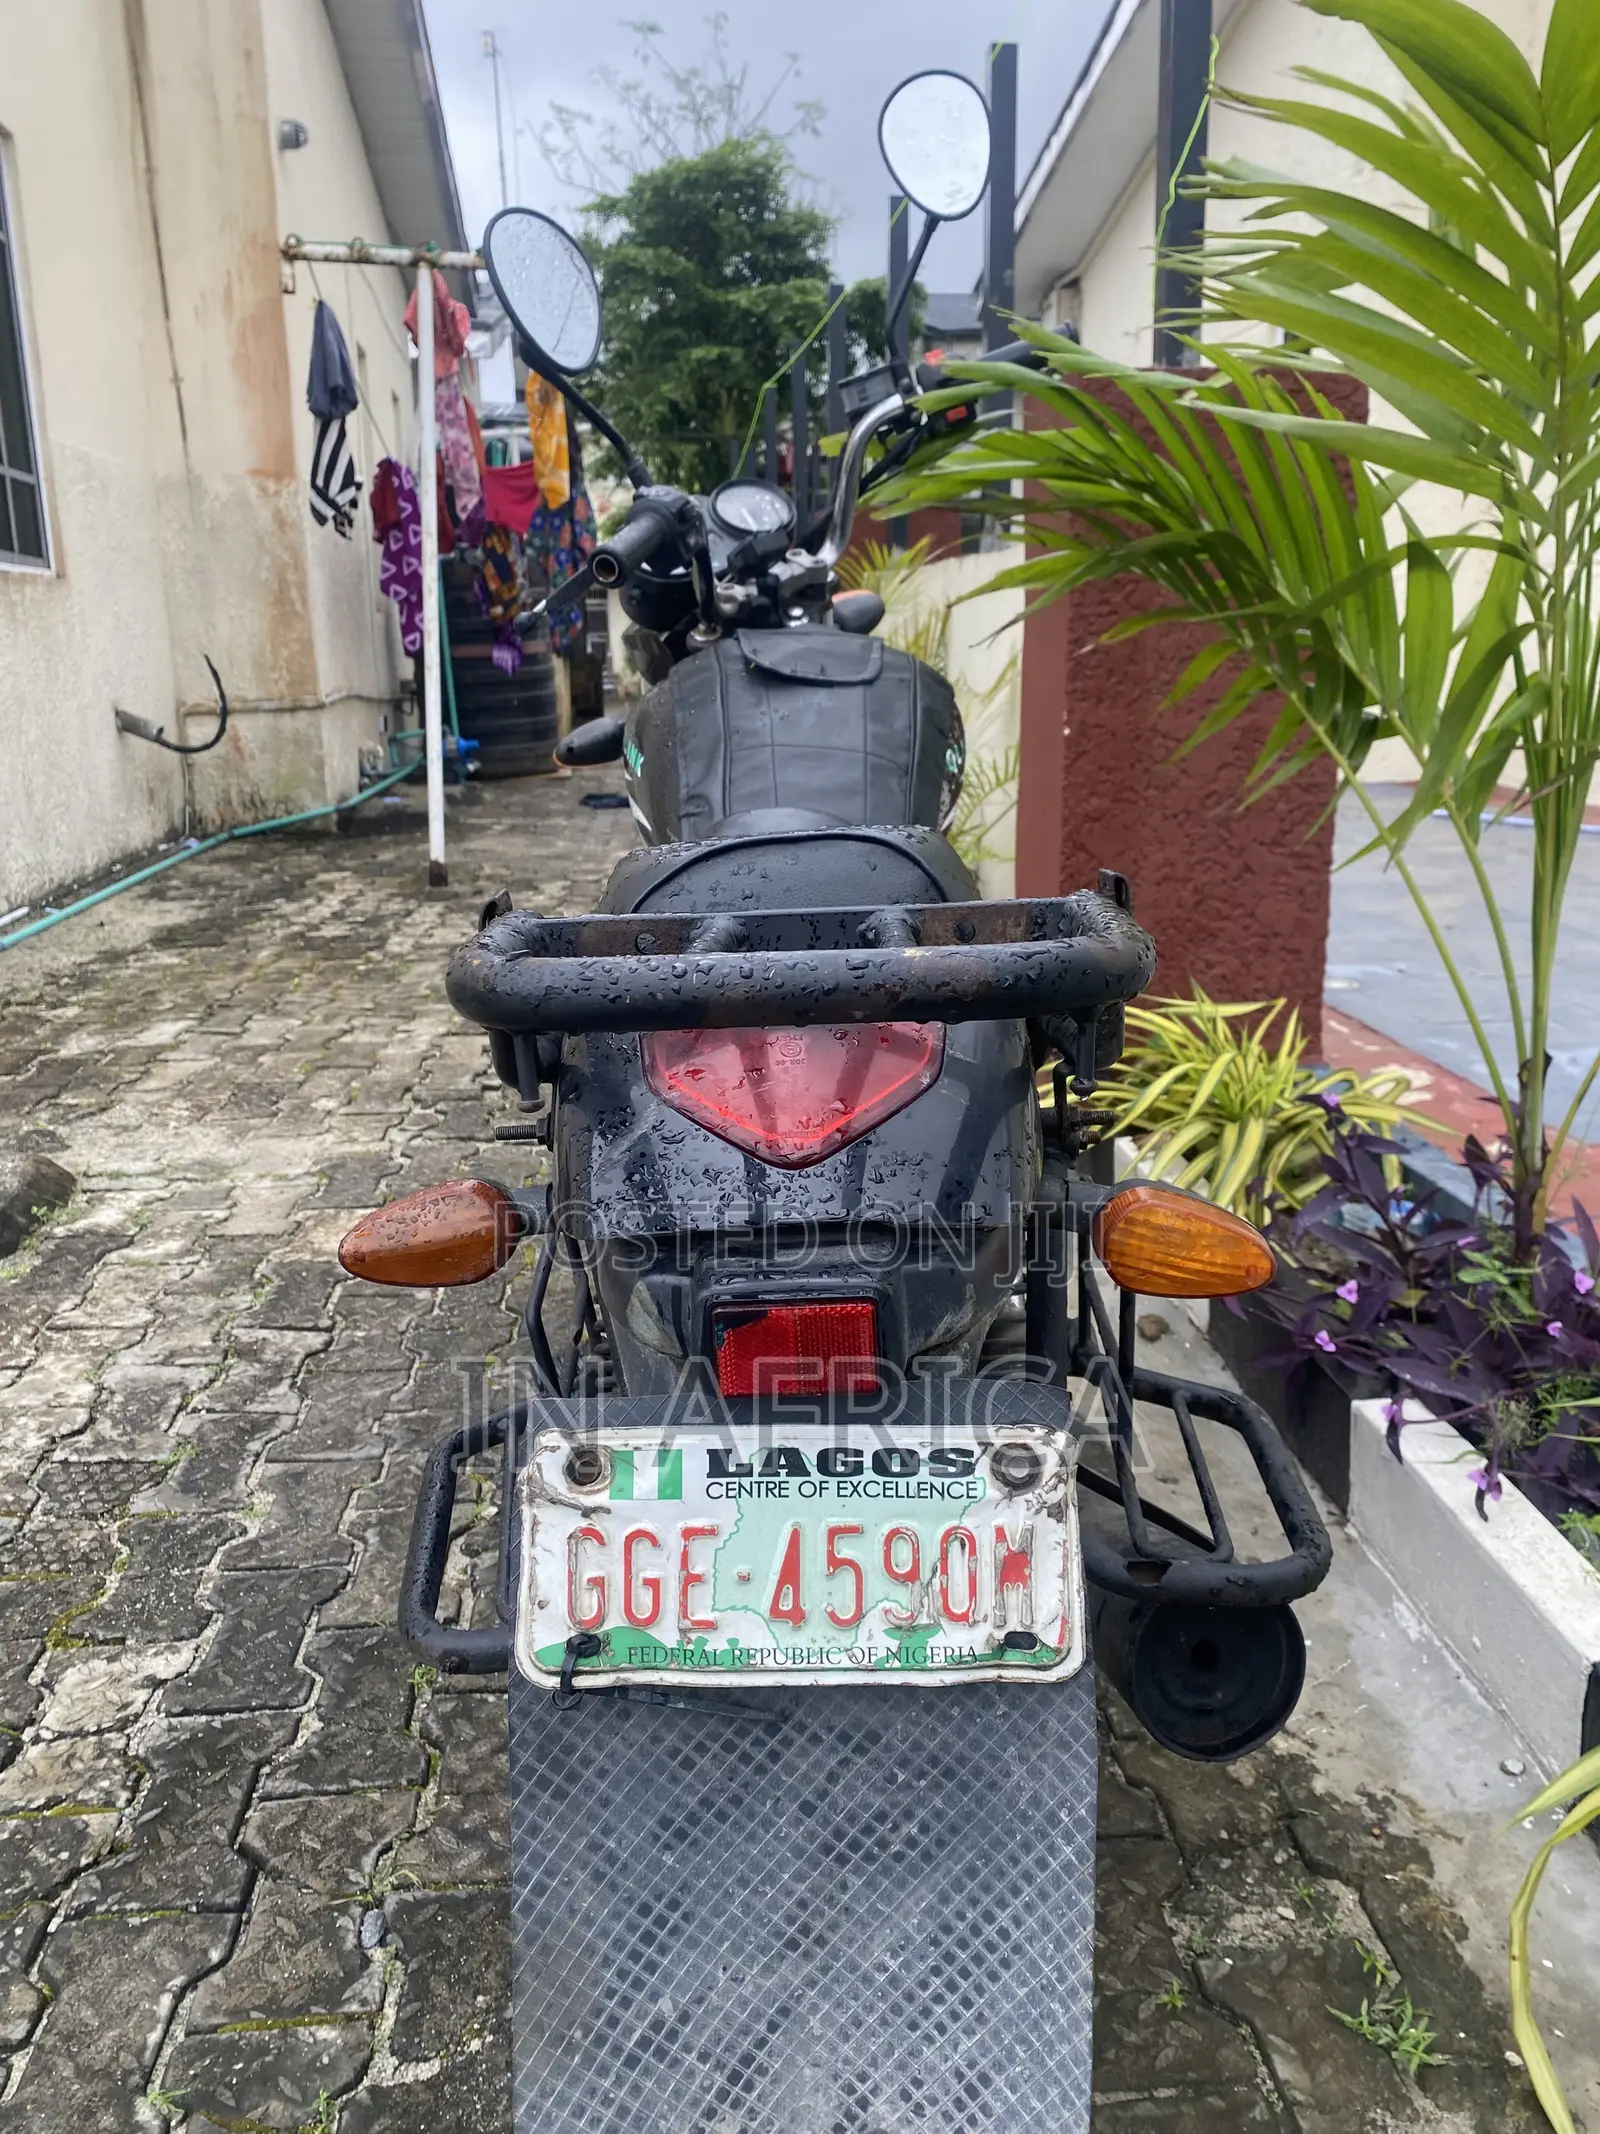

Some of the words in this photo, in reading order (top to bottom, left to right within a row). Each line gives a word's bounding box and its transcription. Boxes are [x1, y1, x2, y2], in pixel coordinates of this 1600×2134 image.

[706, 1447, 976, 1479] LAGOS
[705, 1480, 790, 1500] CENTRE
[798, 1480, 830, 1499] OF
[836, 1480, 979, 1500] EXCELLENCE
[627, 1646, 724, 1666] FEDERAL
[730, 1646, 842, 1666] REPUBLIC
[847, 1645, 879, 1666] OF
[885, 1645, 979, 1665] NIGERIA
